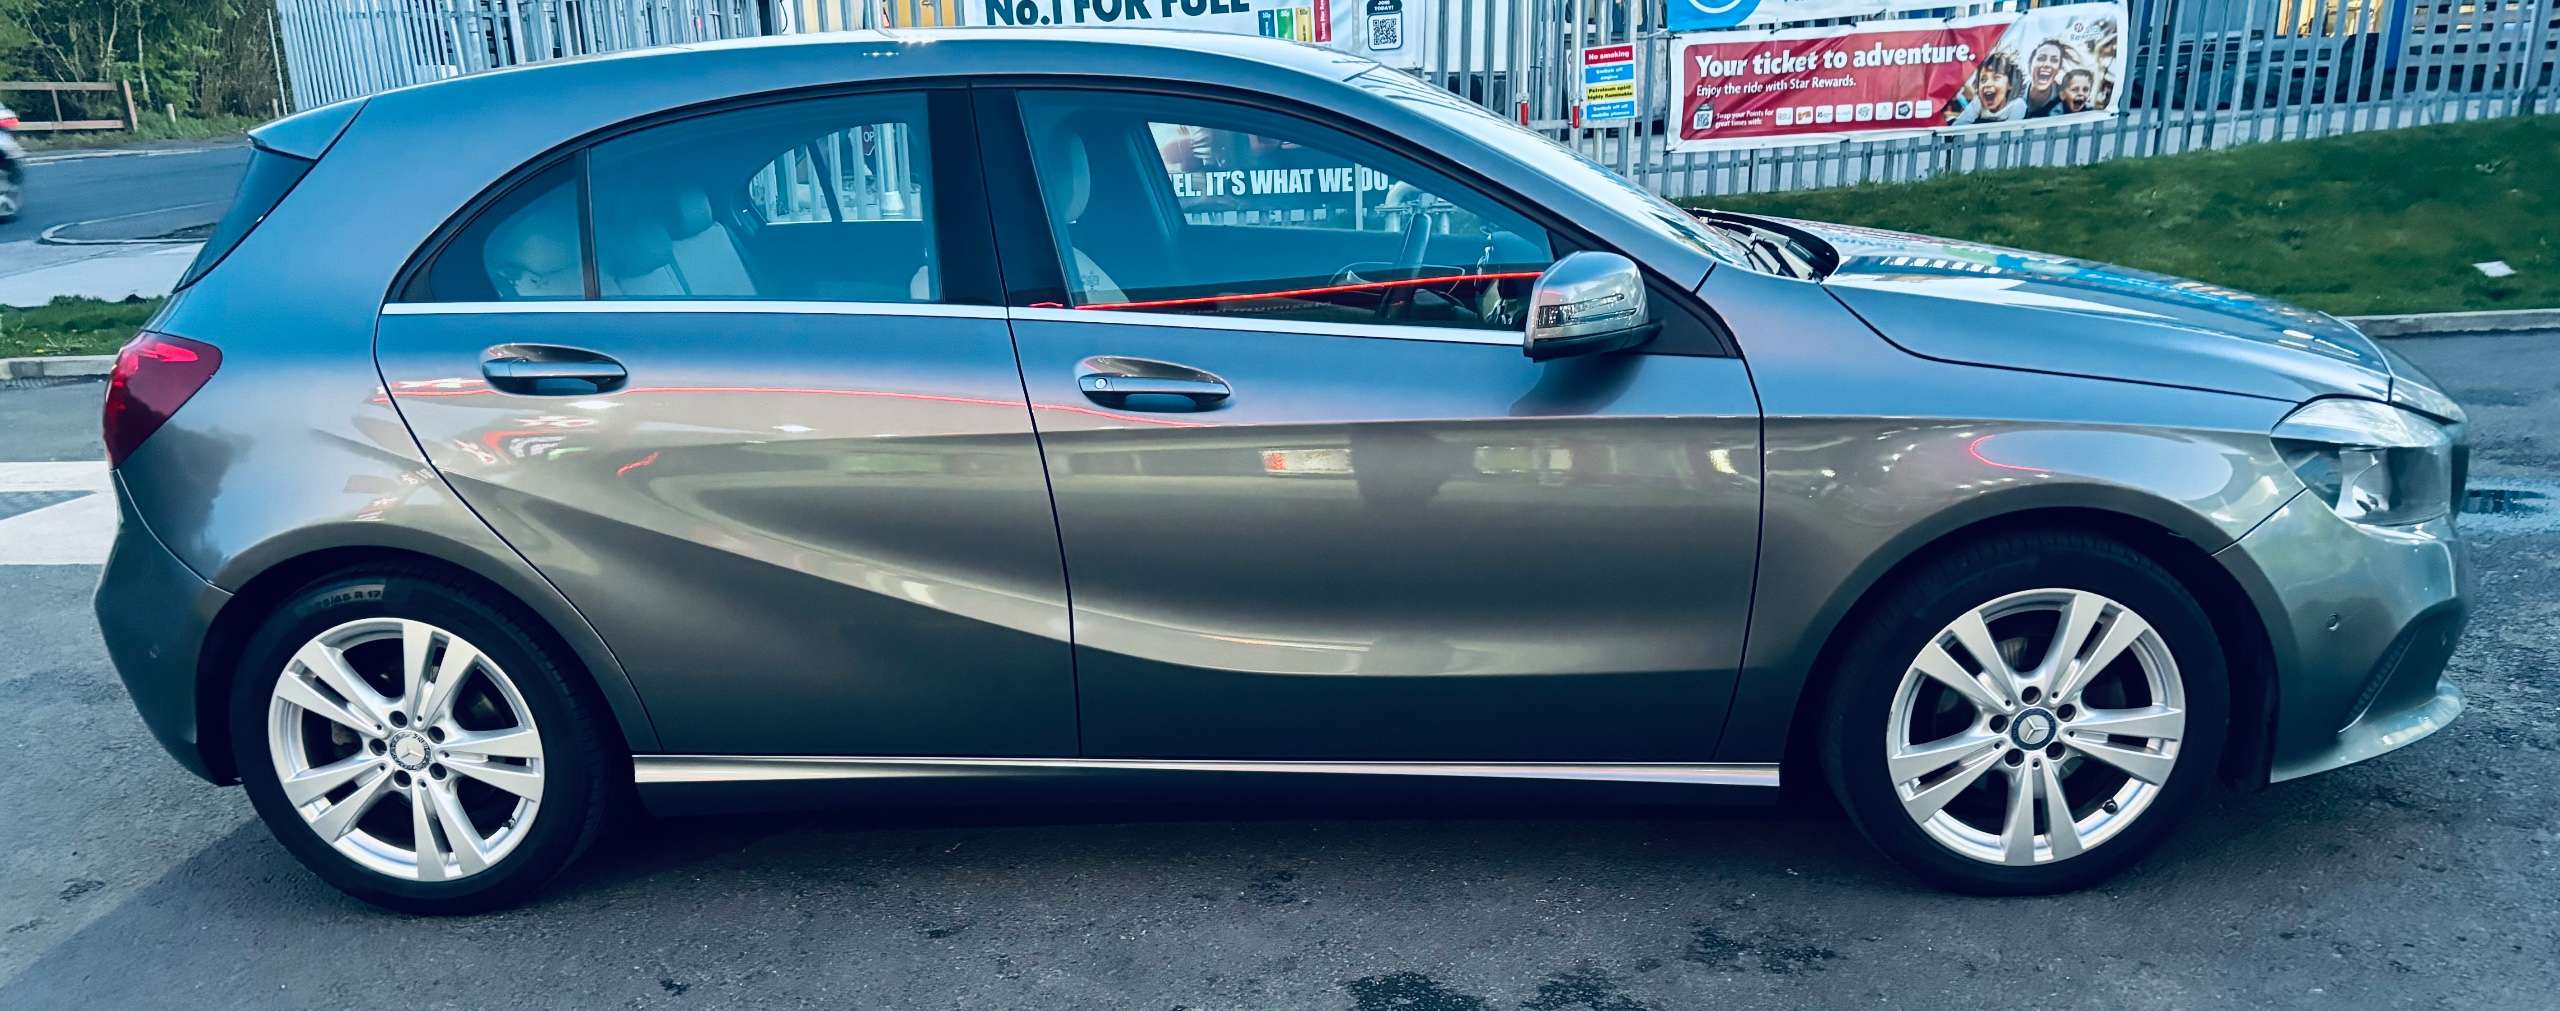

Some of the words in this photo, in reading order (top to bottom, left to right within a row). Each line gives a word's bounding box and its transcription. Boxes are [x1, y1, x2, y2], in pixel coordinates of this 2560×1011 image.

[985, 0, 1062, 26] No.1
[1074, 0, 1152, 23] FOR
[1600, 51, 1630, 59] smoking
[1695, 55, 1747, 78] Your
[1752, 50, 1818, 74] ticket
[1823, 48, 1848, 69] to
[1853, 41, 1976, 68] adventure.
[1696, 84, 1721, 98] Enjoy
[1724, 82, 1741, 94] the
[1743, 81, 1763, 93] ride
[1765, 79, 1787, 91] with
[1789, 78, 1810, 90] Star
[1812, 76, 1857, 88] Rewards.
[1731, 111, 1746, 119] your
[1715, 120, 1730, 129] great
[863, 131, 874, 142] OP
[1249, 168, 1314, 195] WHAT
[1318, 167, 1353, 192] WE
[367, 590, 382, 598] 17
